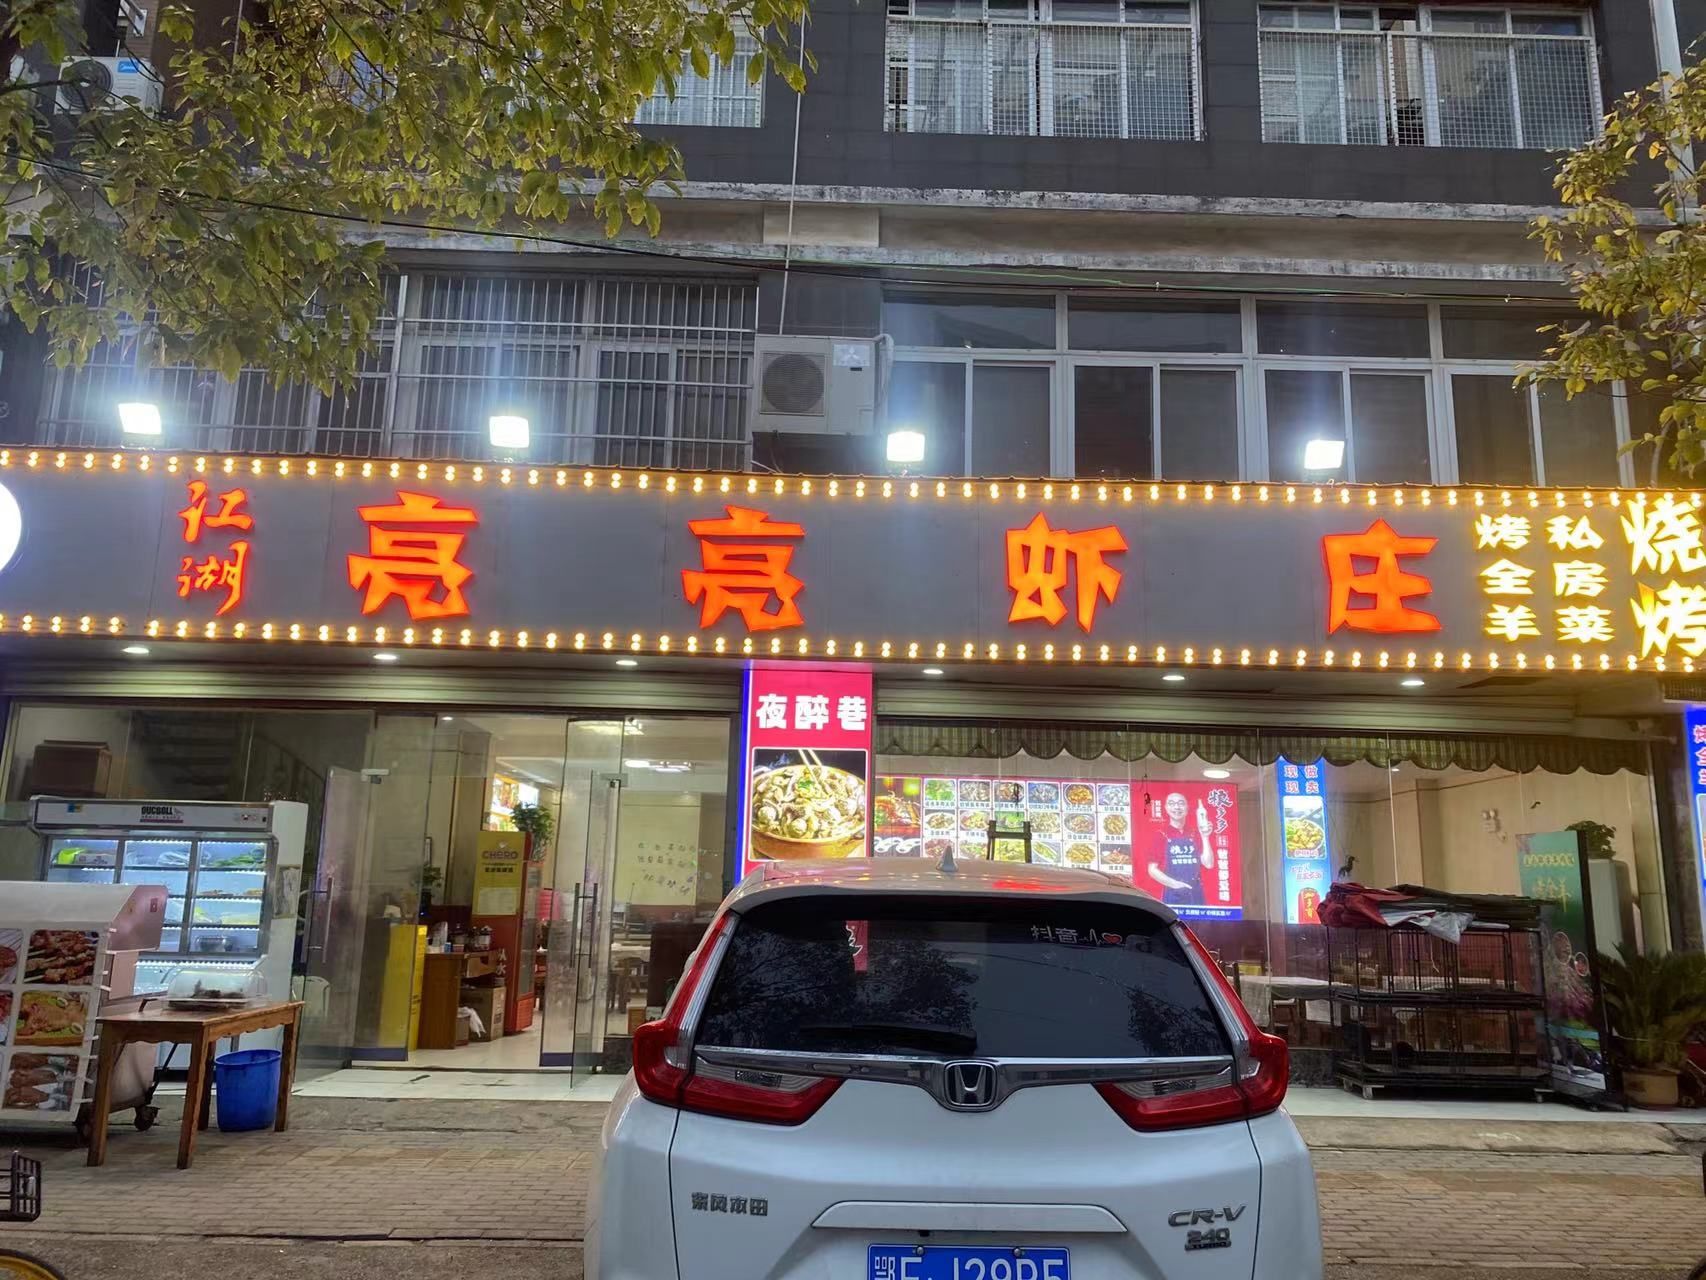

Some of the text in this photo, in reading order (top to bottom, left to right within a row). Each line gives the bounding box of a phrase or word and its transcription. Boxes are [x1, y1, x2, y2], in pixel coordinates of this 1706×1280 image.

[177, 480, 254, 617] 江湖
[347, 490, 1442, 634] 亮亮虾庄
[1474, 512, 1541, 642] 烤全羊
[1545, 513, 1615, 643] 私房菜
[1620, 497, 1706, 660] 烧烤
[755, 693, 867, 731] 夜醉巷
[1284, 764, 1319, 779] 现做
[1285, 780, 1320, 794] 现卖
[1030, 925, 1078, 943] 抖音
[1168, 1204, 1247, 1227] CR-V
[1186, 1227, 1231, 1243] 240
